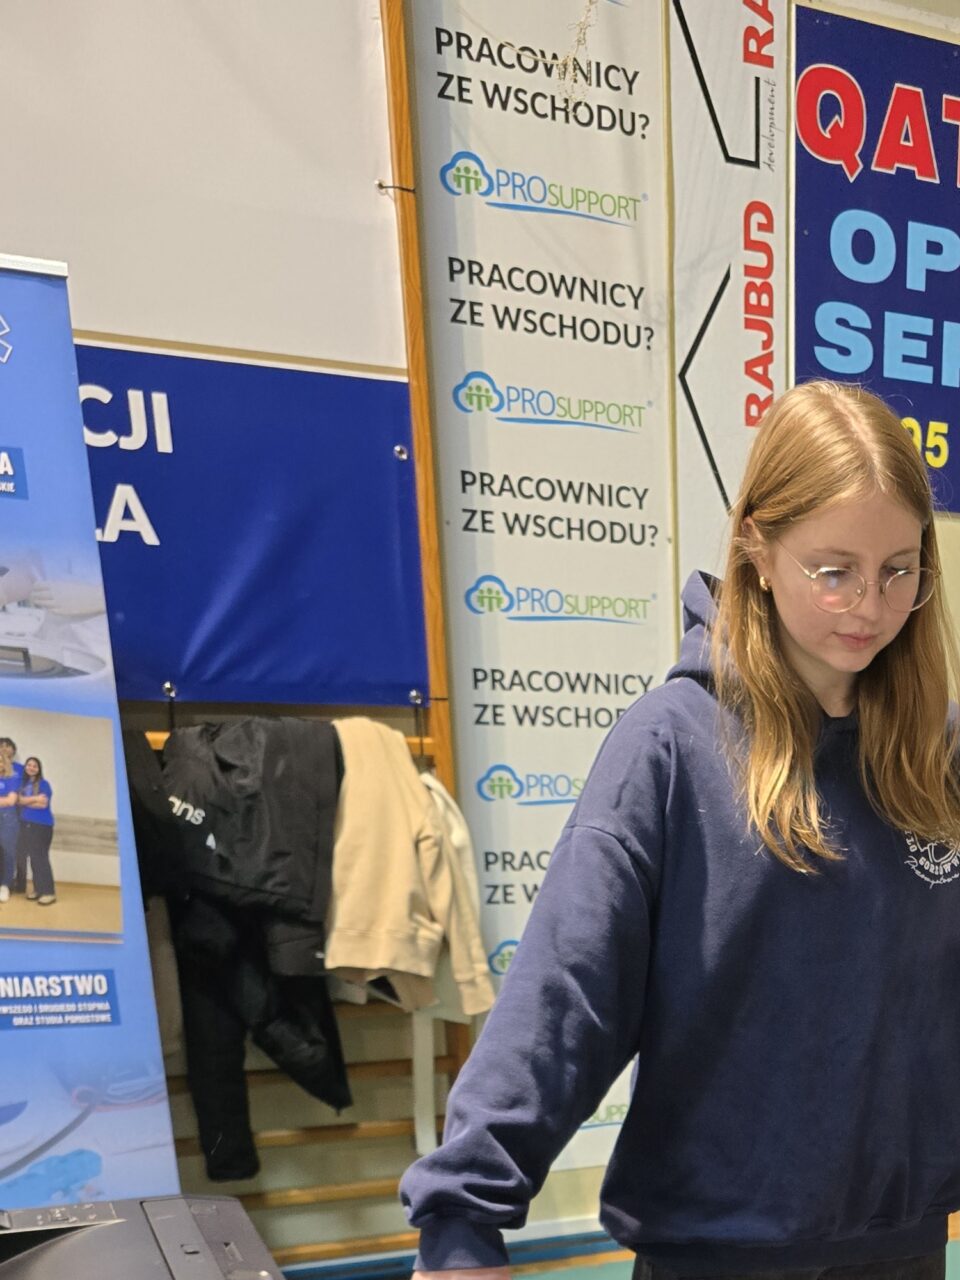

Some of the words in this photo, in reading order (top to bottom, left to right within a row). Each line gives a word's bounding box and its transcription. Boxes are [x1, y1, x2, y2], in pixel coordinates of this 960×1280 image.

[435, 27, 640, 96] PRACOWNICY
[437, 71, 474, 105] ZE
[480, 80, 650, 140] WSCHODU?
[495, 168, 641, 222] PROSUPPORT
[448, 256, 645, 310] PRACOWNICY
[449, 298, 485, 327] ZE
[492, 304, 655, 351] WSCHODU?
[744, 201, 775, 428] RAJBUD
[78, 384, 173, 453] CJI
[506, 386, 646, 427] PROSUPPORT
[95, 484, 160, 546] A
[460, 470, 649, 510] PRACOWNICY
[461, 508, 495, 533] ZE
[502, 512, 659, 547] WSCHODU?
[515, 587, 651, 620] PROSUPPORT
[472, 668, 653, 696] PRACOWNICY
[474, 704, 505, 726] ZE
[486, 885, 515, 905] ZE
